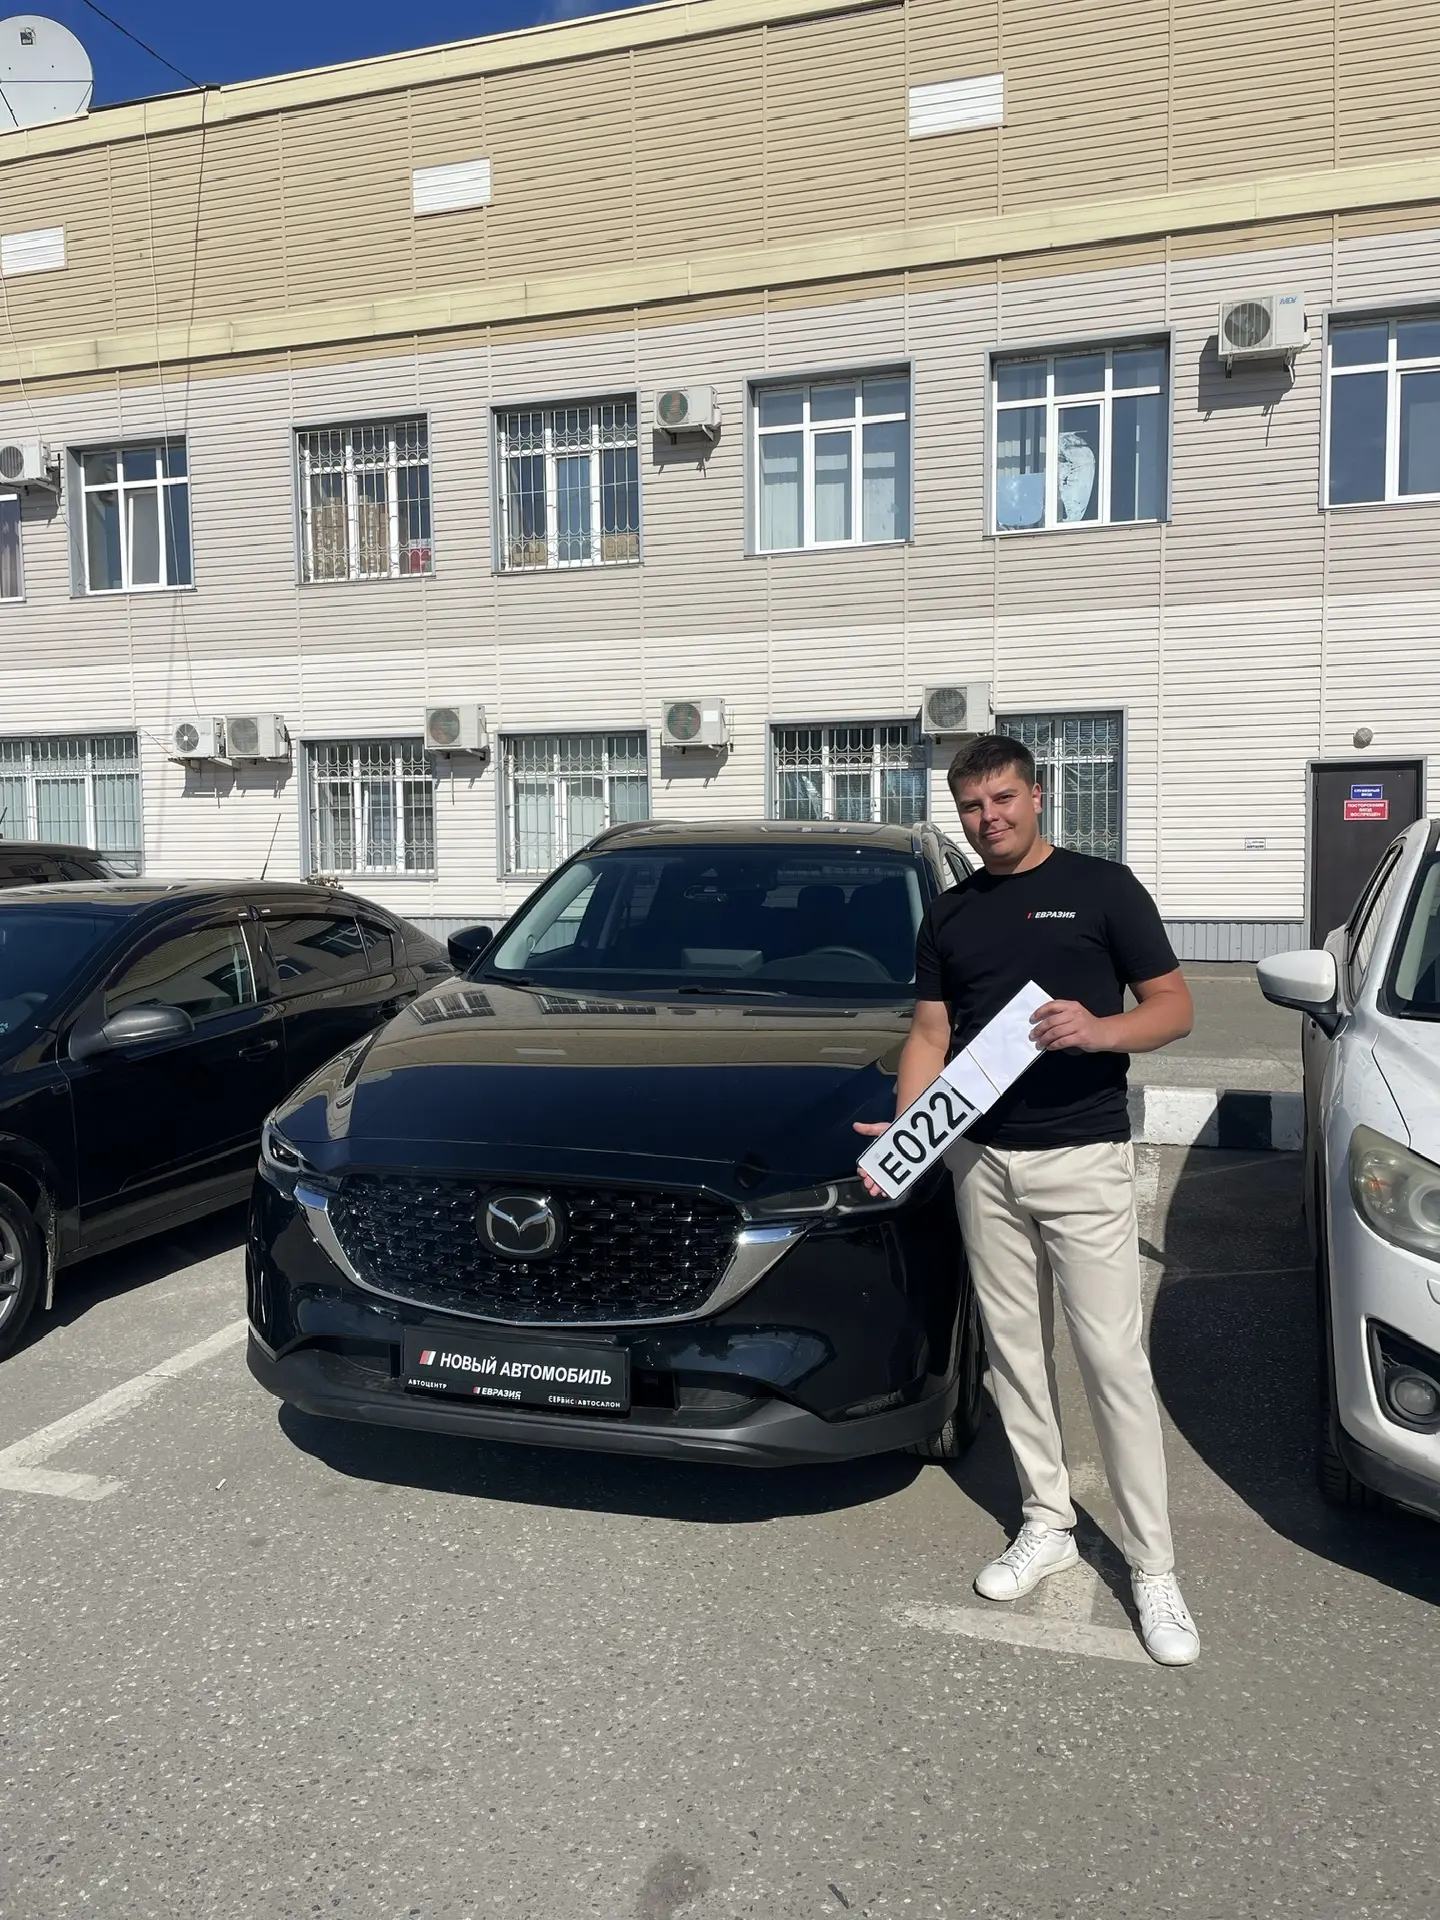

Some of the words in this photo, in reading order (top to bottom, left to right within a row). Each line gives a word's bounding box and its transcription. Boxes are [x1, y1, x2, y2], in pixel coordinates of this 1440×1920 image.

[1034, 911, 1077, 919] ЕВРАЗИЯ
[440, 1352, 497, 1375] НОВЫЙ
[500, 1361, 612, 1386] АВТОМОБИЛЬ
[408, 1379, 447, 1389] АВТОЦЕНТР
[481, 1387, 522, 1400] ЕВРАЗИЯ
[577, 1399, 621, 1408] АВТОСАЛОН
